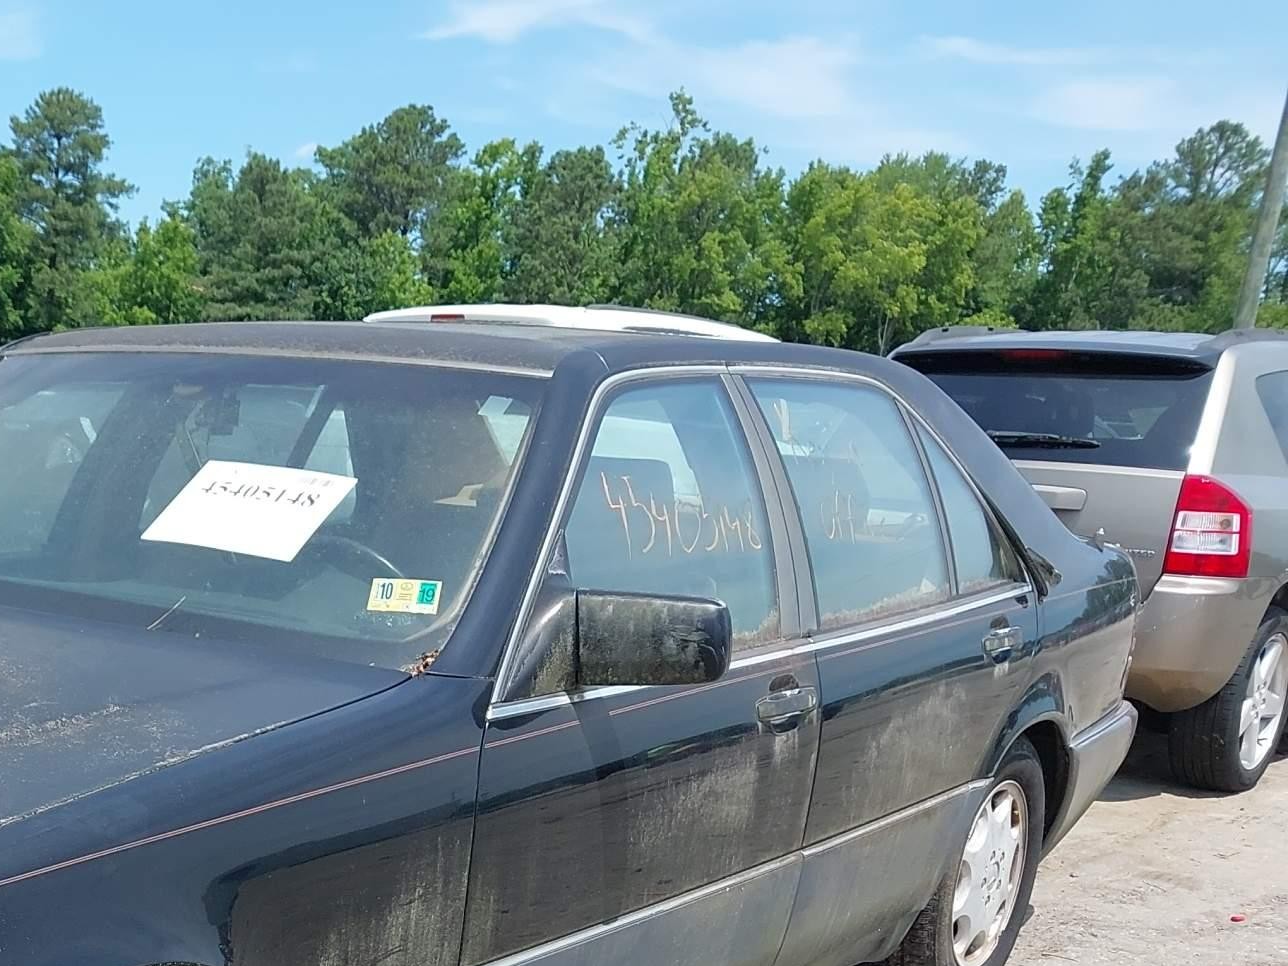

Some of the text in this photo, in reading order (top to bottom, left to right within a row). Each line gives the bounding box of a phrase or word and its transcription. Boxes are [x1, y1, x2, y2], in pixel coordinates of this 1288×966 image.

[201, 480, 321, 507] 45405148
[380, 582, 394, 600] 10
[418, 588, 436, 603] 19
